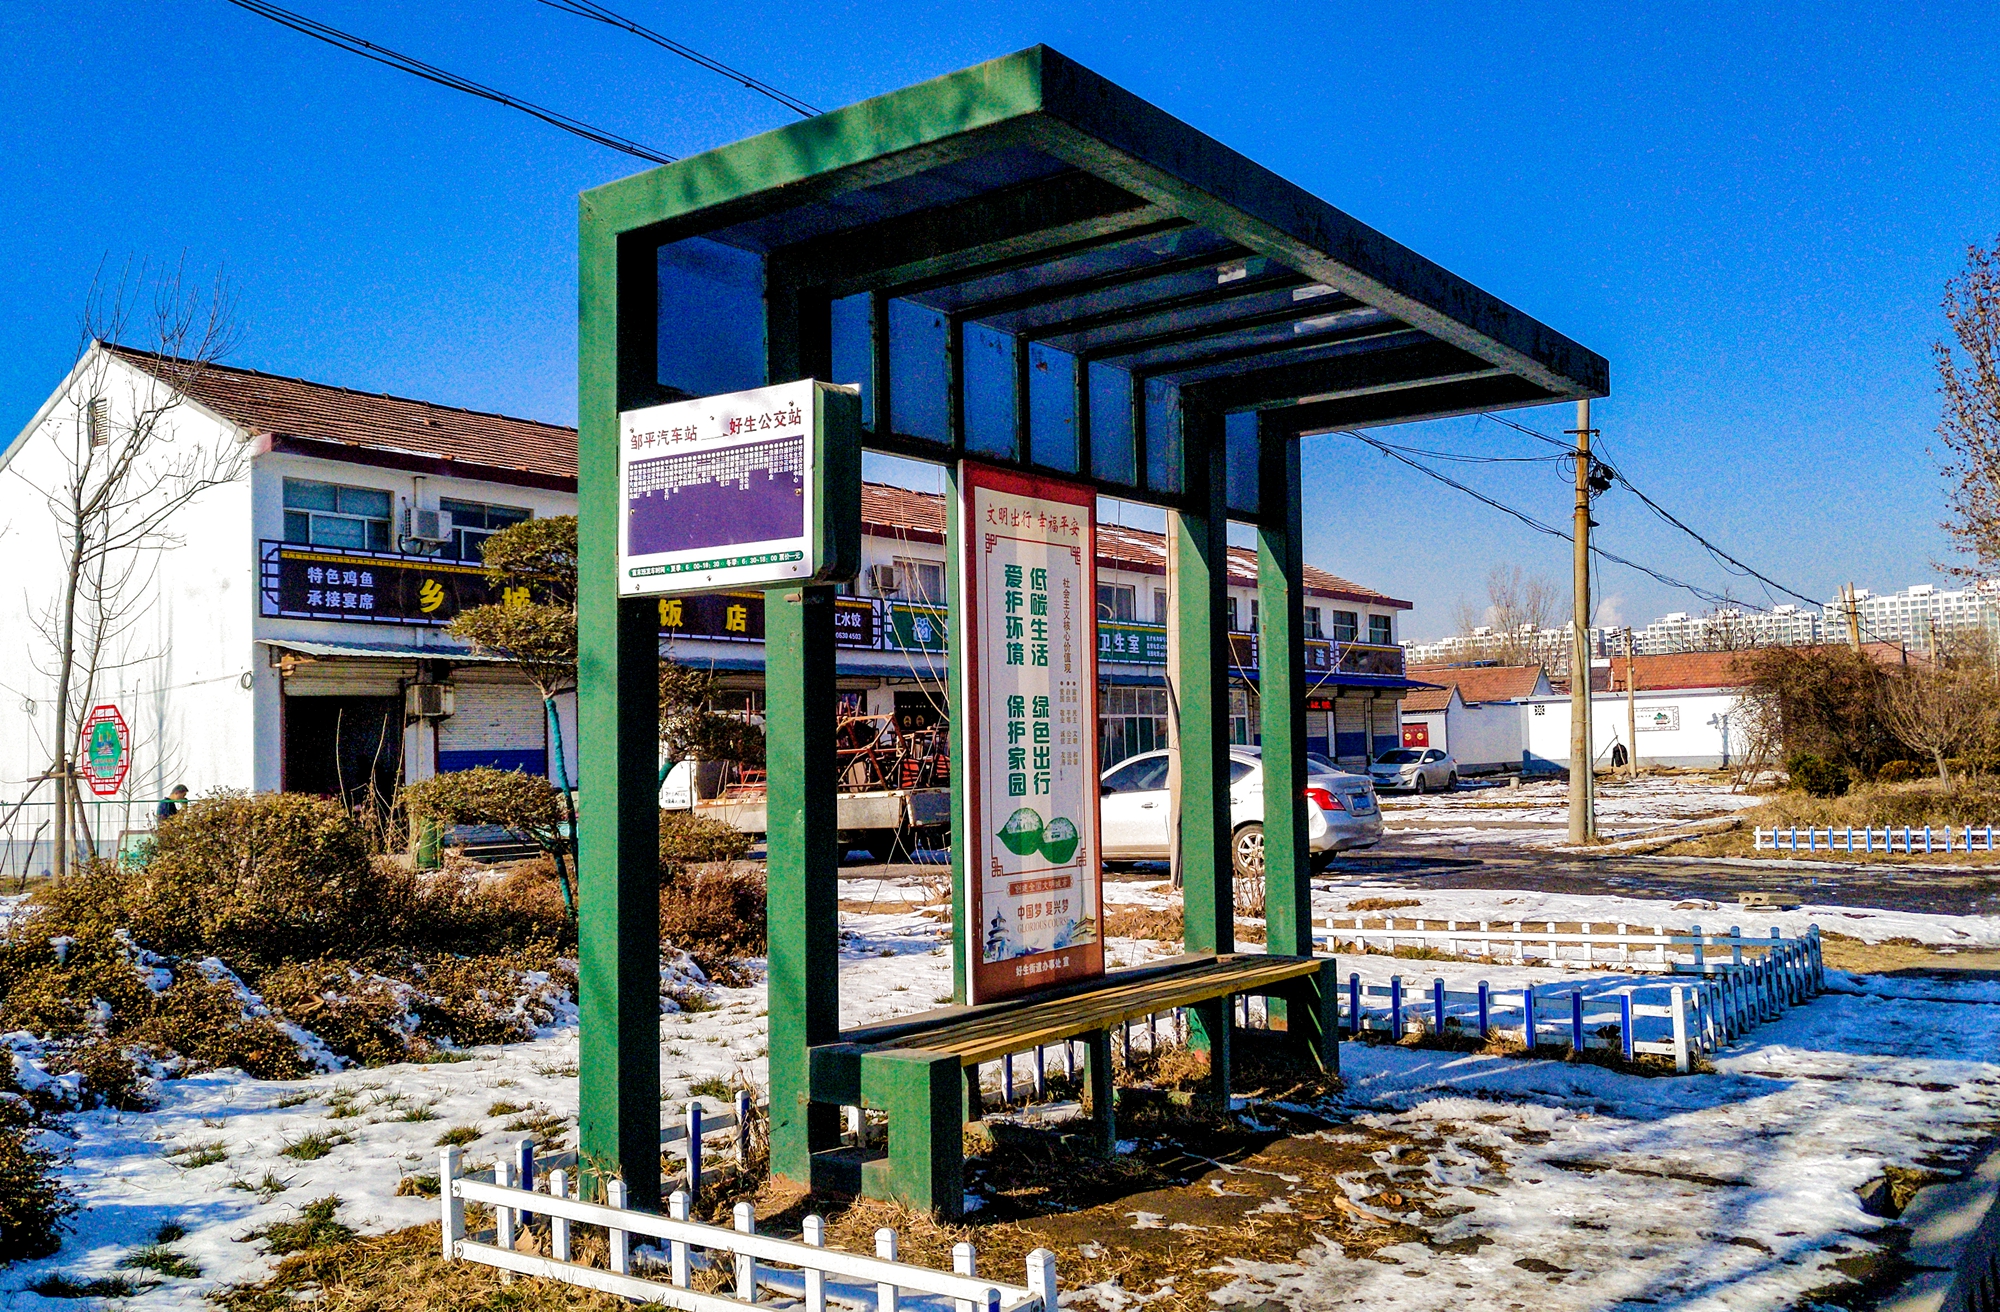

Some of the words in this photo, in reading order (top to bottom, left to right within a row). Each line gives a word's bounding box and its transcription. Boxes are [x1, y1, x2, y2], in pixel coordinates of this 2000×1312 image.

[630, 424, 698, 450] 邹平汽车站
[729, 407, 802, 435] 好生公交站
[985, 503, 1031, 528] 文明出行
[1037, 511, 1080, 537] 幸福平安
[307, 566, 374, 588] 特色鸡鱼
[307, 590, 374, 610] 承接宴席
[1004, 564, 1024, 666] 爱护环境
[1030, 567, 1048, 667] 低碳生活
[1062, 578, 1072, 673] 社会主义核心价值观
[1098, 632, 1140, 654] 卫生室
[1007, 695, 1026, 796] 保护家园
[1032, 695, 1050, 795] 绿色出行
[1014, 877, 1068, 893] 创建全国文明城市
[1017, 902, 1042, 920] 中国梦
[1045, 899, 1069, 917] 复兴梦
[1017, 920, 1047, 934] GLORIOUS
[1015, 959, 1062, 977] 好生街道办事处
